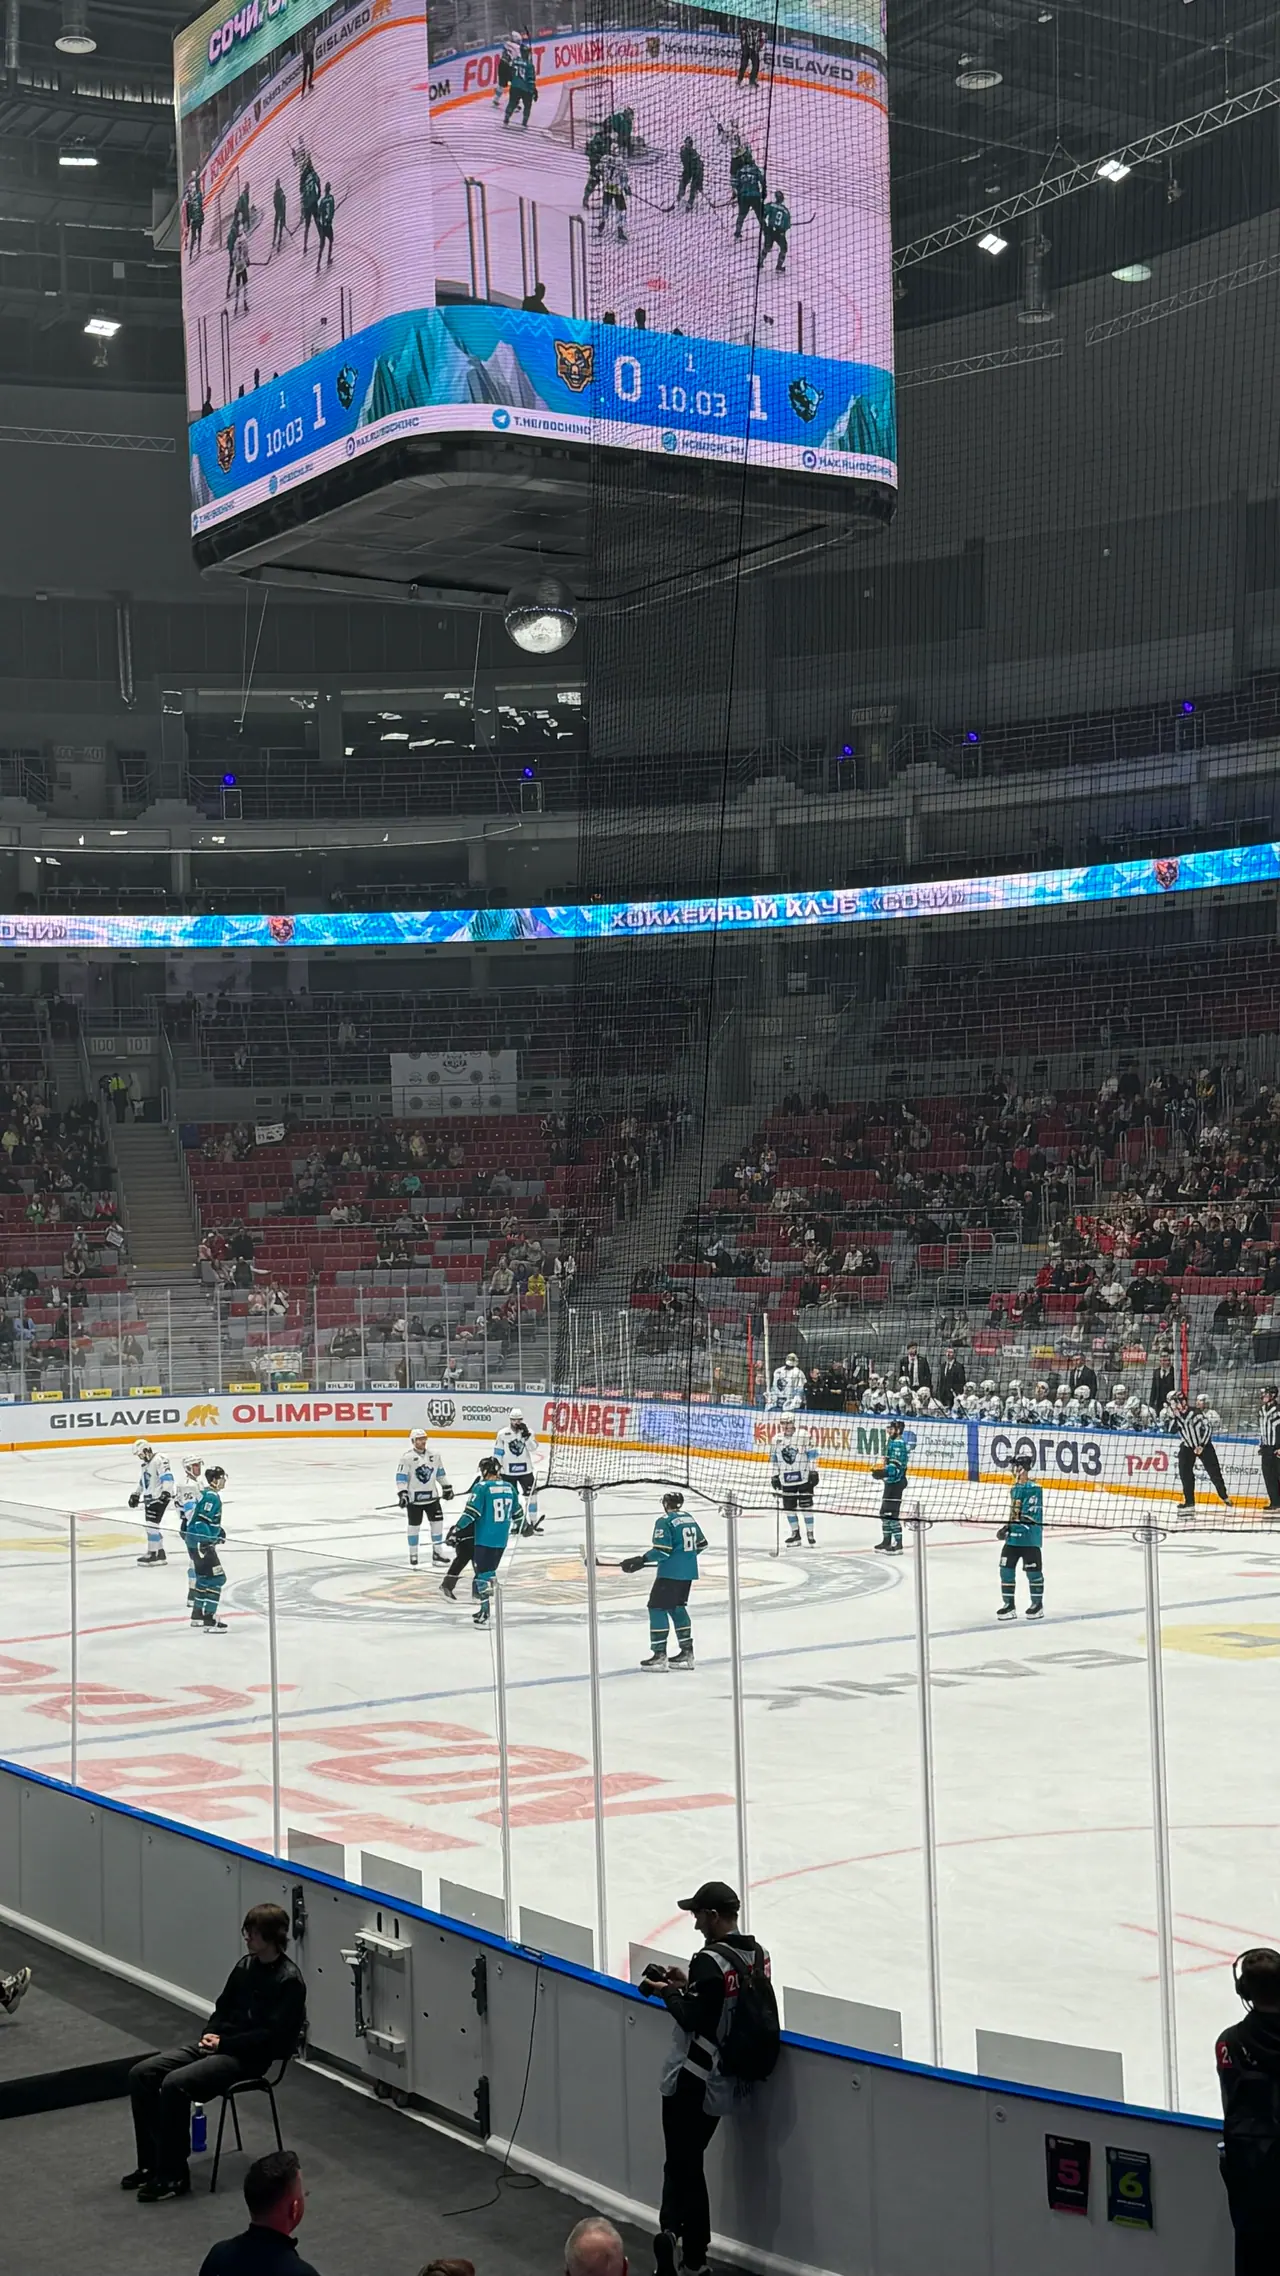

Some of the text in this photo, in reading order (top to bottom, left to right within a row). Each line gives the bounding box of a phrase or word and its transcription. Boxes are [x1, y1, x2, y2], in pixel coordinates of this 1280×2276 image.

[684, 352, 696, 373] 1
[279, 390, 286, 409] 1
[613, 355, 768, 421] 0 10:03 1
[243, 383, 327, 463] 0 10:03 1
[610, 896, 778, 928] ХОККЕЙНЫЙ
[785, 896, 859, 918] КЛУБ
[93, 1038, 114, 1052] 100
[50, 1408, 181, 1430] GISLAVED
[231, 1401, 394, 1424] OLIMPBET
[432, 1401, 451, 1417] 80
[542, 1401, 631, 1438] FONBET
[493, 1498, 513, 1522] 87
[1056, 2157, 1081, 2188] 5
[1118, 2171, 1144, 2199] 6
